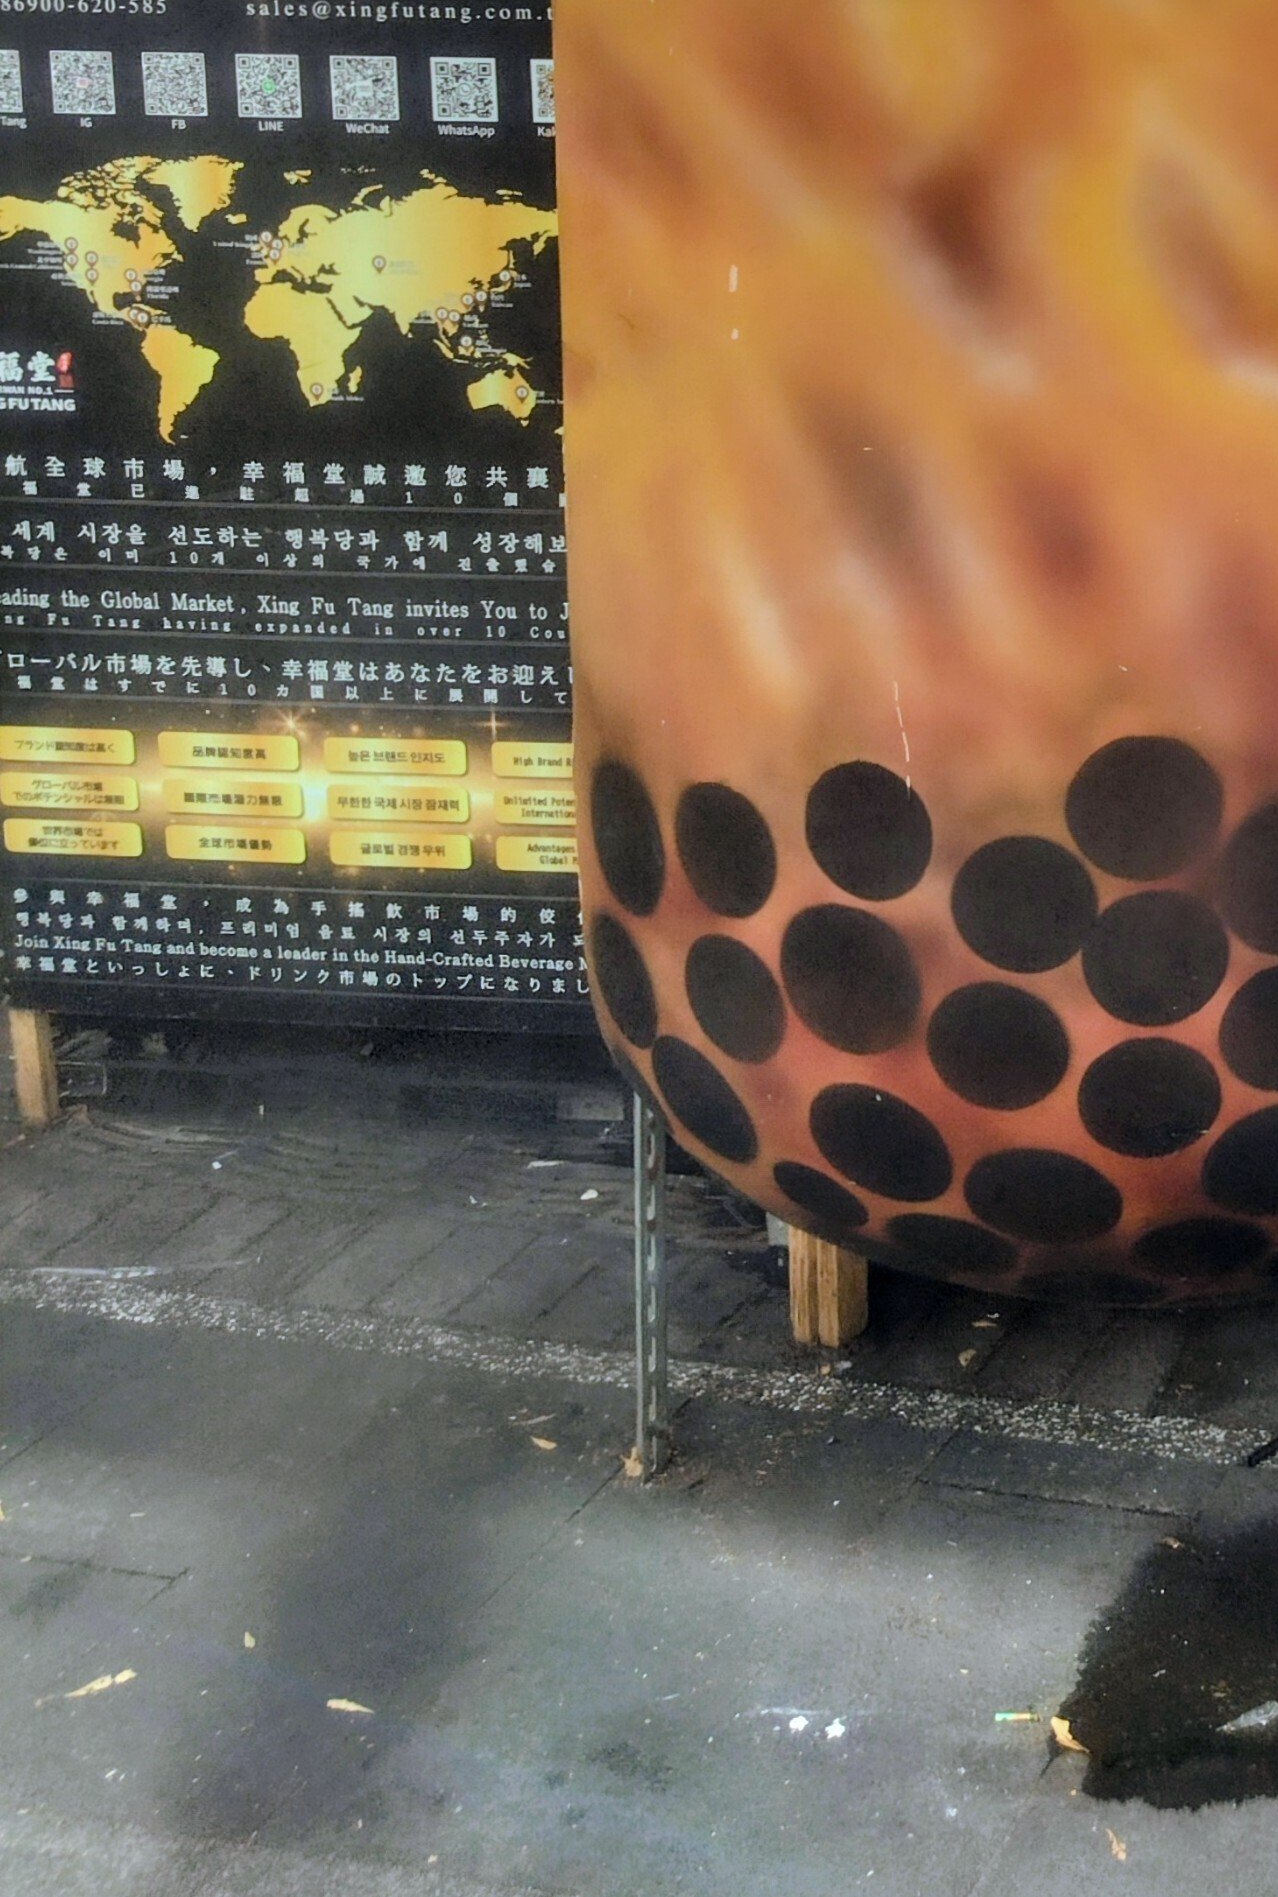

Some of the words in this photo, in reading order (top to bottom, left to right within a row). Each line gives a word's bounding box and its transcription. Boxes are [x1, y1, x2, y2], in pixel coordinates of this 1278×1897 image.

[80, 117, 93, 129] IG
[171, 119, 187, 130] FB
[258, 120, 284, 132] LINE
[345, 122, 390, 135] WeChat
[437, 124, 495, 138] WhatsApp
[12, 520, 56, 542] 세계
[78, 521, 146, 545] 시장을
[168, 524, 262, 548] 선도하는
[284, 528, 380, 551] 행복당과
[403, 530, 448, 553] 함께
[0, 588, 50, 610] ading
[61, 590, 90, 608] the
[101, 590, 160, 611] Global
[257, 595, 300, 617] Xing
[311, 596, 335, 616] Fu
[347, 597, 394, 619] Tang
[405, 599, 470, 618] invites
[480, 600, 518, 620] You
[529, 602, 548, 621] to
[47, 613, 70, 626] Fu
[92, 614, 141, 630] Tang
[163, 617, 231, 632] having
[255, 621, 351, 635] expanded
[374, 623, 393, 636] in
[417, 625, 462, 637] over
[486, 625, 506, 638] 10
[14, 934, 49, 949] Join
[53, 935, 91, 952] Xing
[95, 938, 116, 952] Fu
[121, 939, 162, 955] Tang
[166, 942, 195, 955] and
[200, 944, 257, 958] become
[263, 948, 273, 959] a
[277, 946, 327, 961] leader
[332, 948, 349, 962] in
[353, 949, 380, 964] the
[384, 950, 494, 968] Hand-Crafted
[498, 955, 573, 973] Beverage
